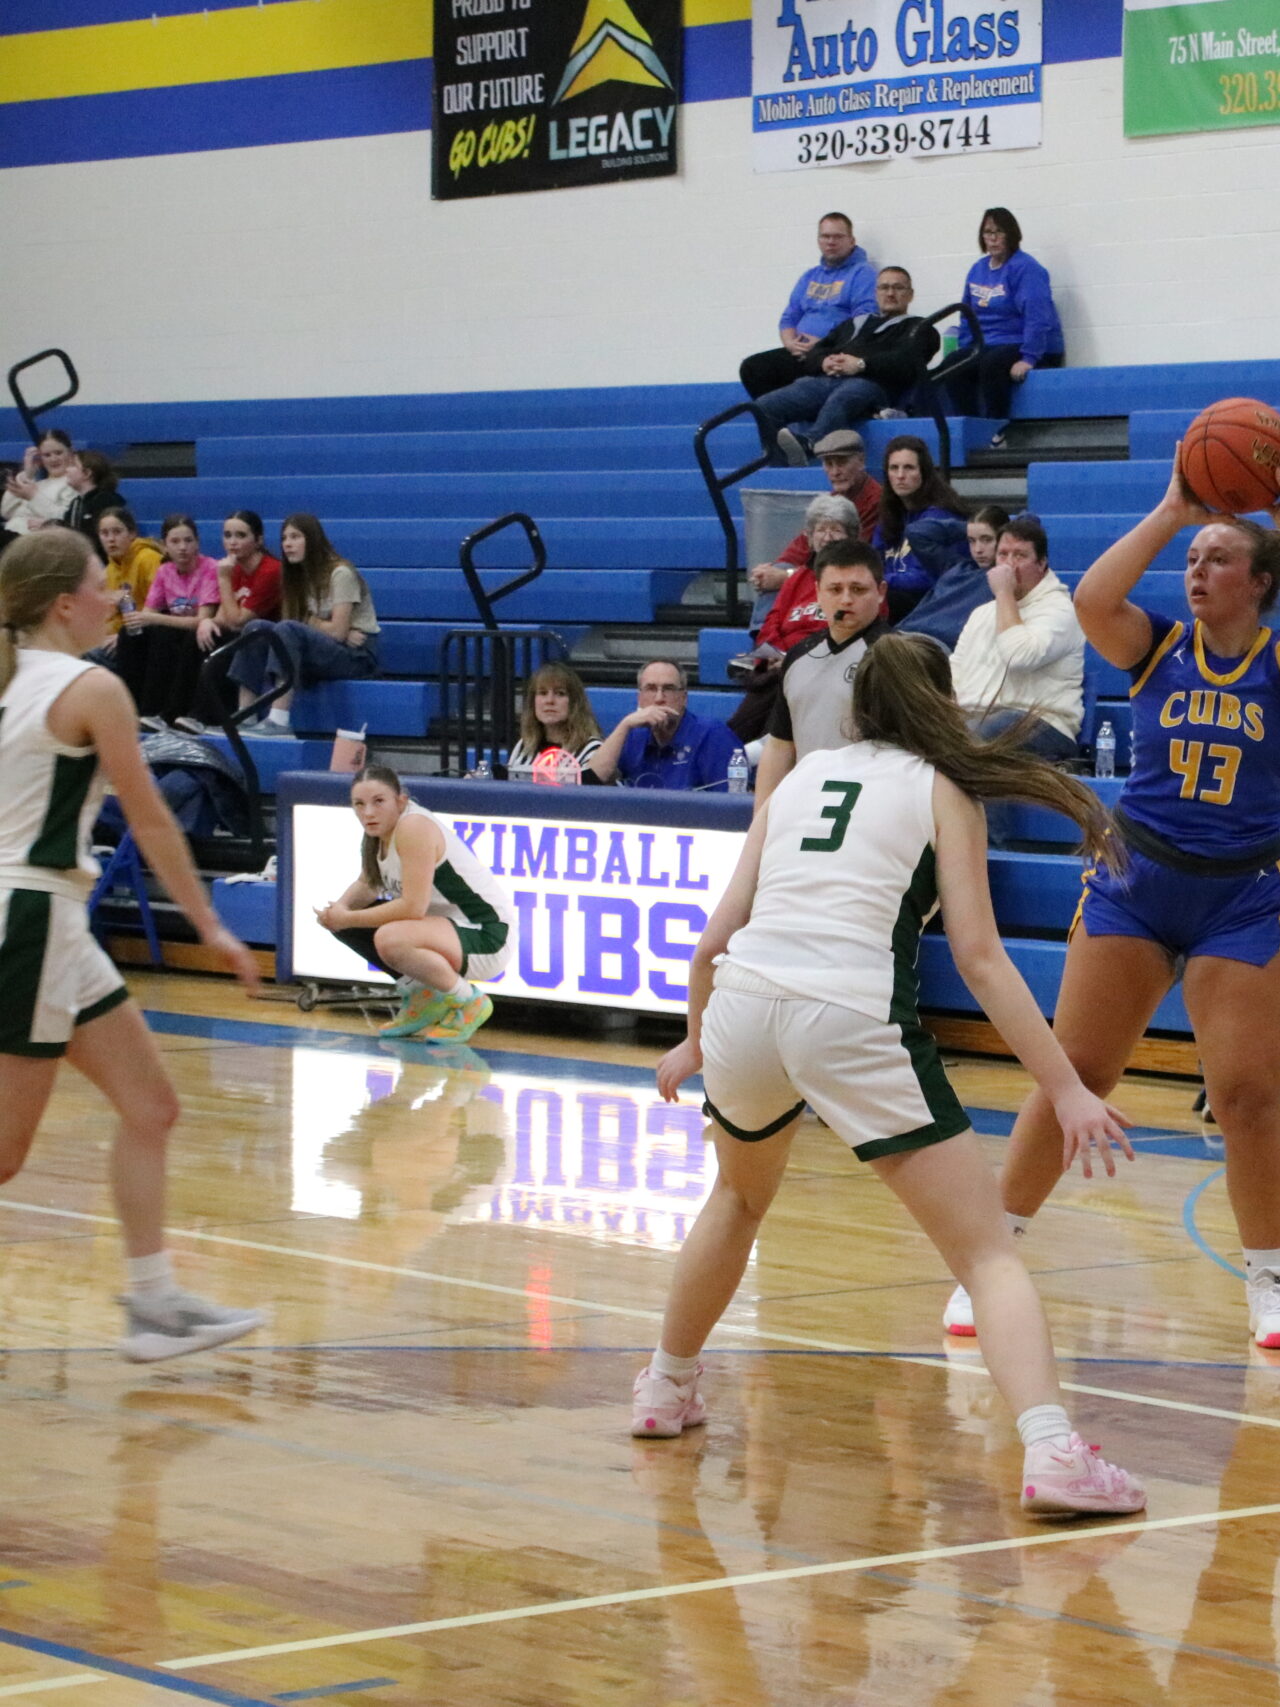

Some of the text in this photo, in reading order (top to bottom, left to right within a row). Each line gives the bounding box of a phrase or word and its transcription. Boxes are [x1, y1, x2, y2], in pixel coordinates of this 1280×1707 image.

[455, 27, 530, 66] SUPPORT
[782, 0, 1020, 84] Auto Glass
[1168, 36, 1188, 65] 75
[1189, 33, 1200, 63] N
[1200, 30, 1234, 61] Main
[442, 73, 546, 115] OUR FUTURE
[758, 69, 1035, 124] Mobile Auto Glass Repair & Replacement
[449, 113, 537, 180] GO CUBS!
[548, 105, 676, 161] LEGACY
[797, 114, 992, 164] 320-339-8744
[1159, 690, 1265, 742] CUBS
[1169, 738, 1243, 806] 43
[799, 780, 863, 853] 3
[453, 820, 709, 891] KIMBALL
[487, 890, 708, 1003] UBS
